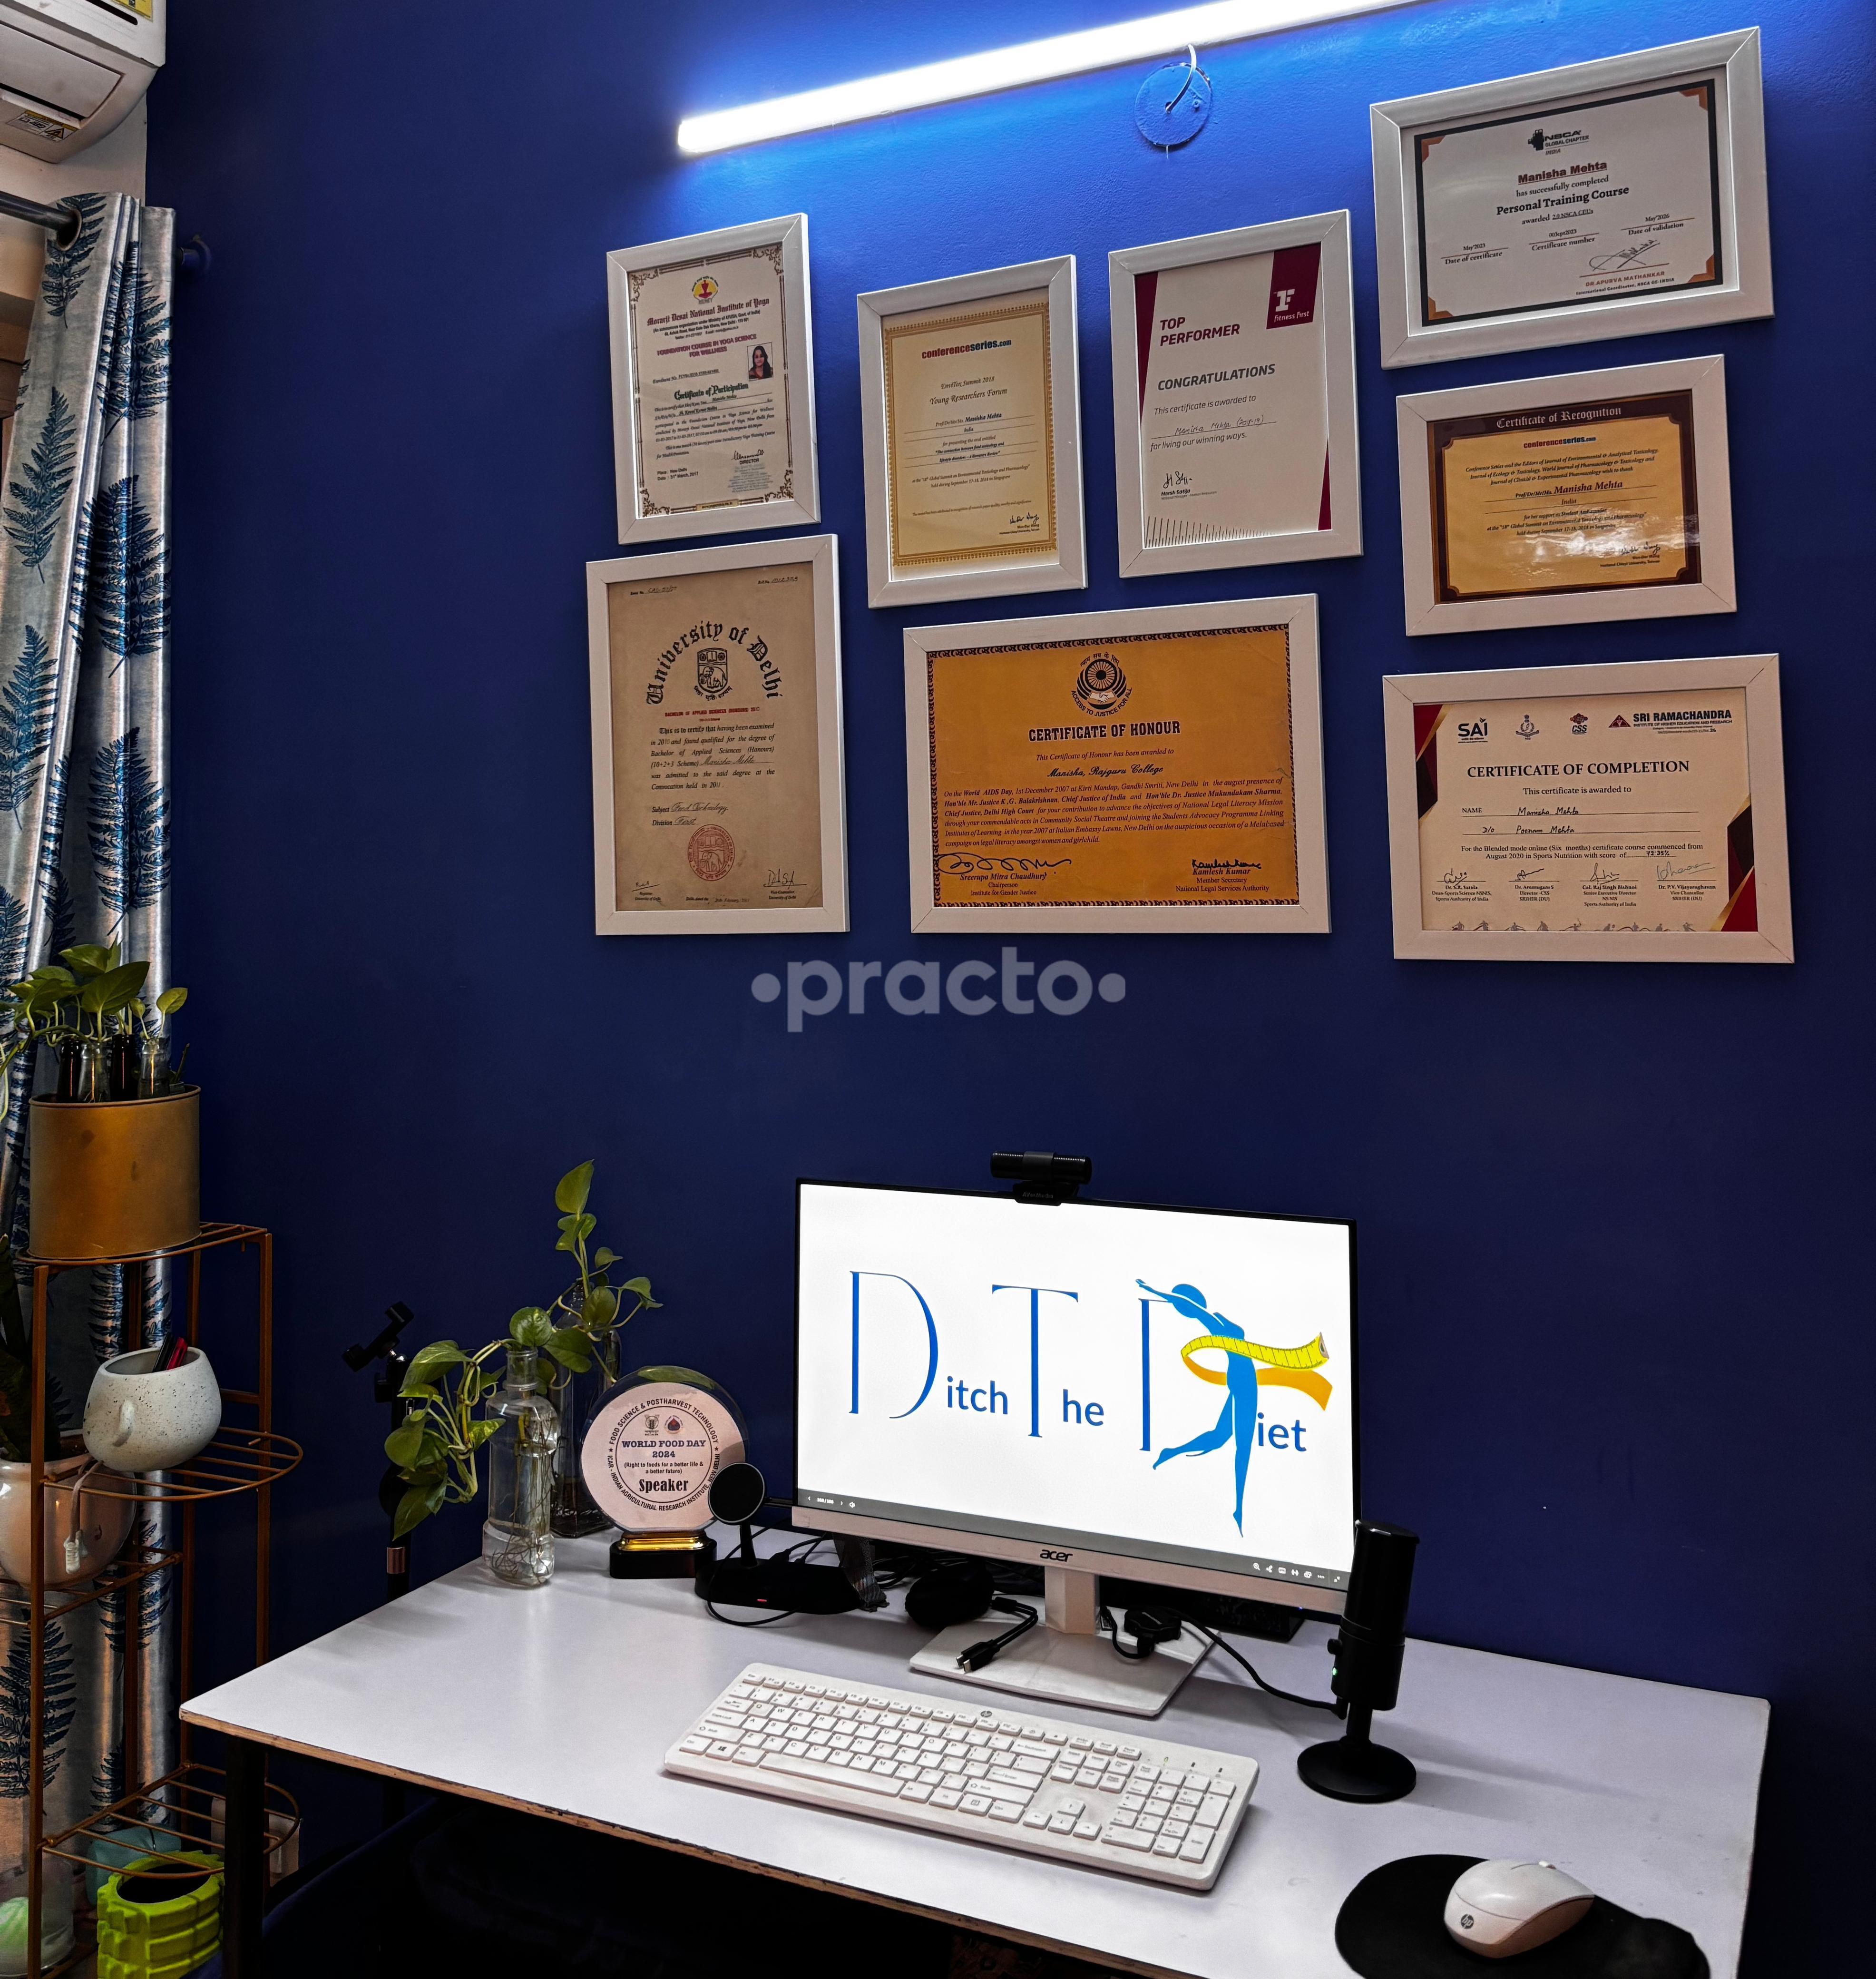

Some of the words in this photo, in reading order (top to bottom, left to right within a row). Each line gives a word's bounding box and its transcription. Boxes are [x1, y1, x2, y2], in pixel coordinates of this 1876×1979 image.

[1544, 130, 1582, 141] NSCA
[1565, 135, 1589, 143] CHAPTER
[1518, 169, 1566, 184] Manisha
[1570, 162, 1607, 175] Mehta
[1529, 182, 1570, 195] successfully
[1571, 175, 1609, 188] completed
[1496, 199, 1541, 215] Personal
[1543, 194, 1589, 207] Training
[1591, 187, 1629, 199] Course
[1522, 214, 1550, 225] awarded
[1652, 222, 1684, 231] validation
[1532, 241, 1567, 251] Certificate
[1569, 237, 1595, 245] number
[1470, 251, 1502, 261] certificate
[671, 312, 688, 321] Desai
[689, 306, 715, 318] National
[717, 302, 743, 313] Institute
[745, 299, 752, 307] of
[753, 298, 769, 308] Yoga
[1274, 314, 1295, 322] Fitness
[1160, 317, 1185, 331] TOP
[1160, 324, 1240, 346] PERFORMER
[921, 340, 1011, 359] conferenceseries.com
[1158, 364, 1275, 391] CONGRATULATIONS
[674, 389, 704, 400] Certificate
[706, 387, 712, 396] of
[712, 382, 748, 395] Participation
[950, 391, 985, 402] Researchers
[1154, 407, 1168, 415] This
[1170, 402, 1205, 412] certificate
[1214, 395, 1247, 406] awarded
[1496, 415, 1545, 428] Certificate
[1549, 412, 1557, 422] of
[1561, 408, 1621, 421] Recognition
[1150, 442, 1161, 452] for
[1162, 441, 1181, 449] living
[1196, 435, 1224, 444] winning
[1524, 437, 1595, 448] conferenceseries.com
[1554, 483, 1592, 494] Manisha
[1594, 480, 1623, 490] Mehta
[646, 620, 723, 705] University
[728, 626, 749, 644] of
[747, 635, 783, 699] Delhi
[1071, 690, 1086, 711] ACCESS
[1094, 707, 1118, 717] JUSTICE
[1117, 698, 1128, 710] FOR
[1633, 713, 1650, 722] SRI
[1653, 710, 1731, 721] RAMACHANDRA
[1029, 725, 1106, 741] CERTIFICATE
[1111, 724, 1125, 737] OF
[1130, 721, 1180, 735] HONOUR
[1458, 722, 1487, 737] SAI
[1081, 752, 1088, 760] of
[1047, 767, 1085, 776] Manisha,
[1088, 766, 1126, 777] Rajguru
[1131, 764, 1163, 775] College
[1467, 764, 1559, 777] CERTIFICATE
[1563, 764, 1583, 774] OF
[1587, 760, 1689, 774] COMPLETION
[850, 1271, 1008, 1419] Ditch
[992, 1284, 1104, 1438] The
[609, 1427, 620, 1445] FOOD
[617, 1407, 640, 1428] SCIENCE
[647, 1398, 692, 1411] POSTHARVEST
[694, 1407, 719, 1443] TECHNOLOGY
[611, 1472, 623, 1490] INDIAN
[621, 1489, 657, 1511] AGRICULTURAL
[658, 1501, 687, 1511] RESEARCH
[707, 1468, 717, 1482] NEW
[639, 1479, 689, 1493] Speaker
[1040, 1549, 1073, 1562] acer
